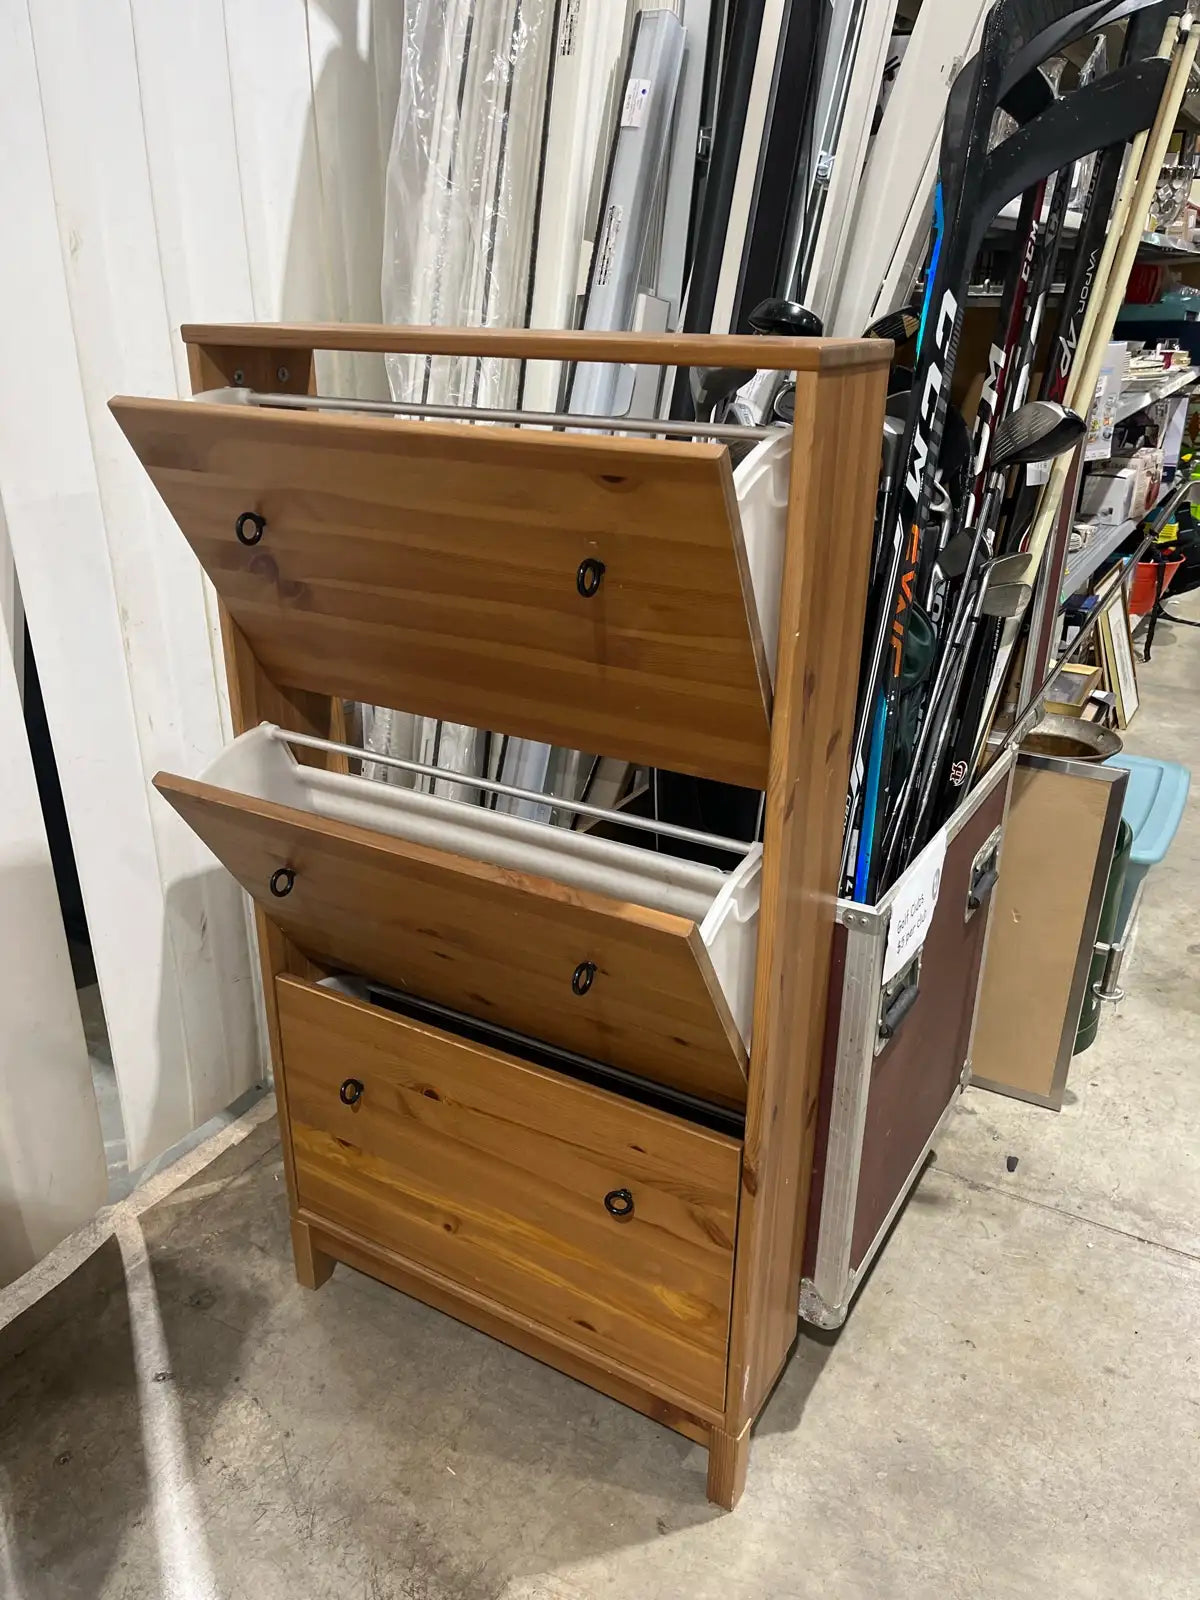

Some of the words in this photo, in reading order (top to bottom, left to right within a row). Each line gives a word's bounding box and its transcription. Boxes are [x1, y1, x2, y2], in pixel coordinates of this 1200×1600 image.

[1021, 219, 1038, 283] CCM
[1076, 248, 1099, 314] VAPOR
[905, 288, 958, 503] CCM
[896, 907, 910, 935] Golf
